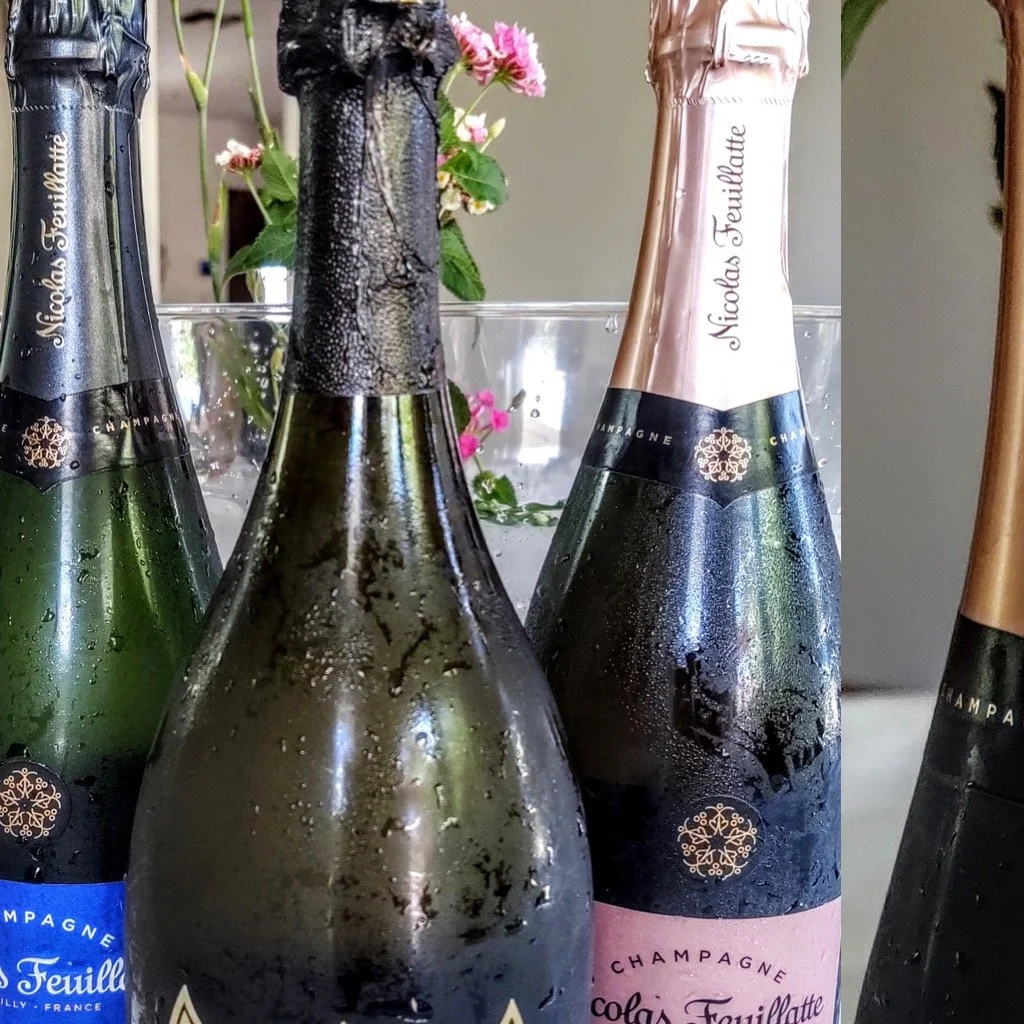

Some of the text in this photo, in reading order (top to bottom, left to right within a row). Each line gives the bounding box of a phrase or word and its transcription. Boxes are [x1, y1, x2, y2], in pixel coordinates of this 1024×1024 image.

[36, 132, 70, 348] Nicolas Feuillatte
[707, 124, 747, 352] Nicolas Feuillatte
[16, 956, 126, 996] Feuill
[610, 949, 787, 984] CHAMPAGNE
[44, 1002, 102, 1013] FRANCE
